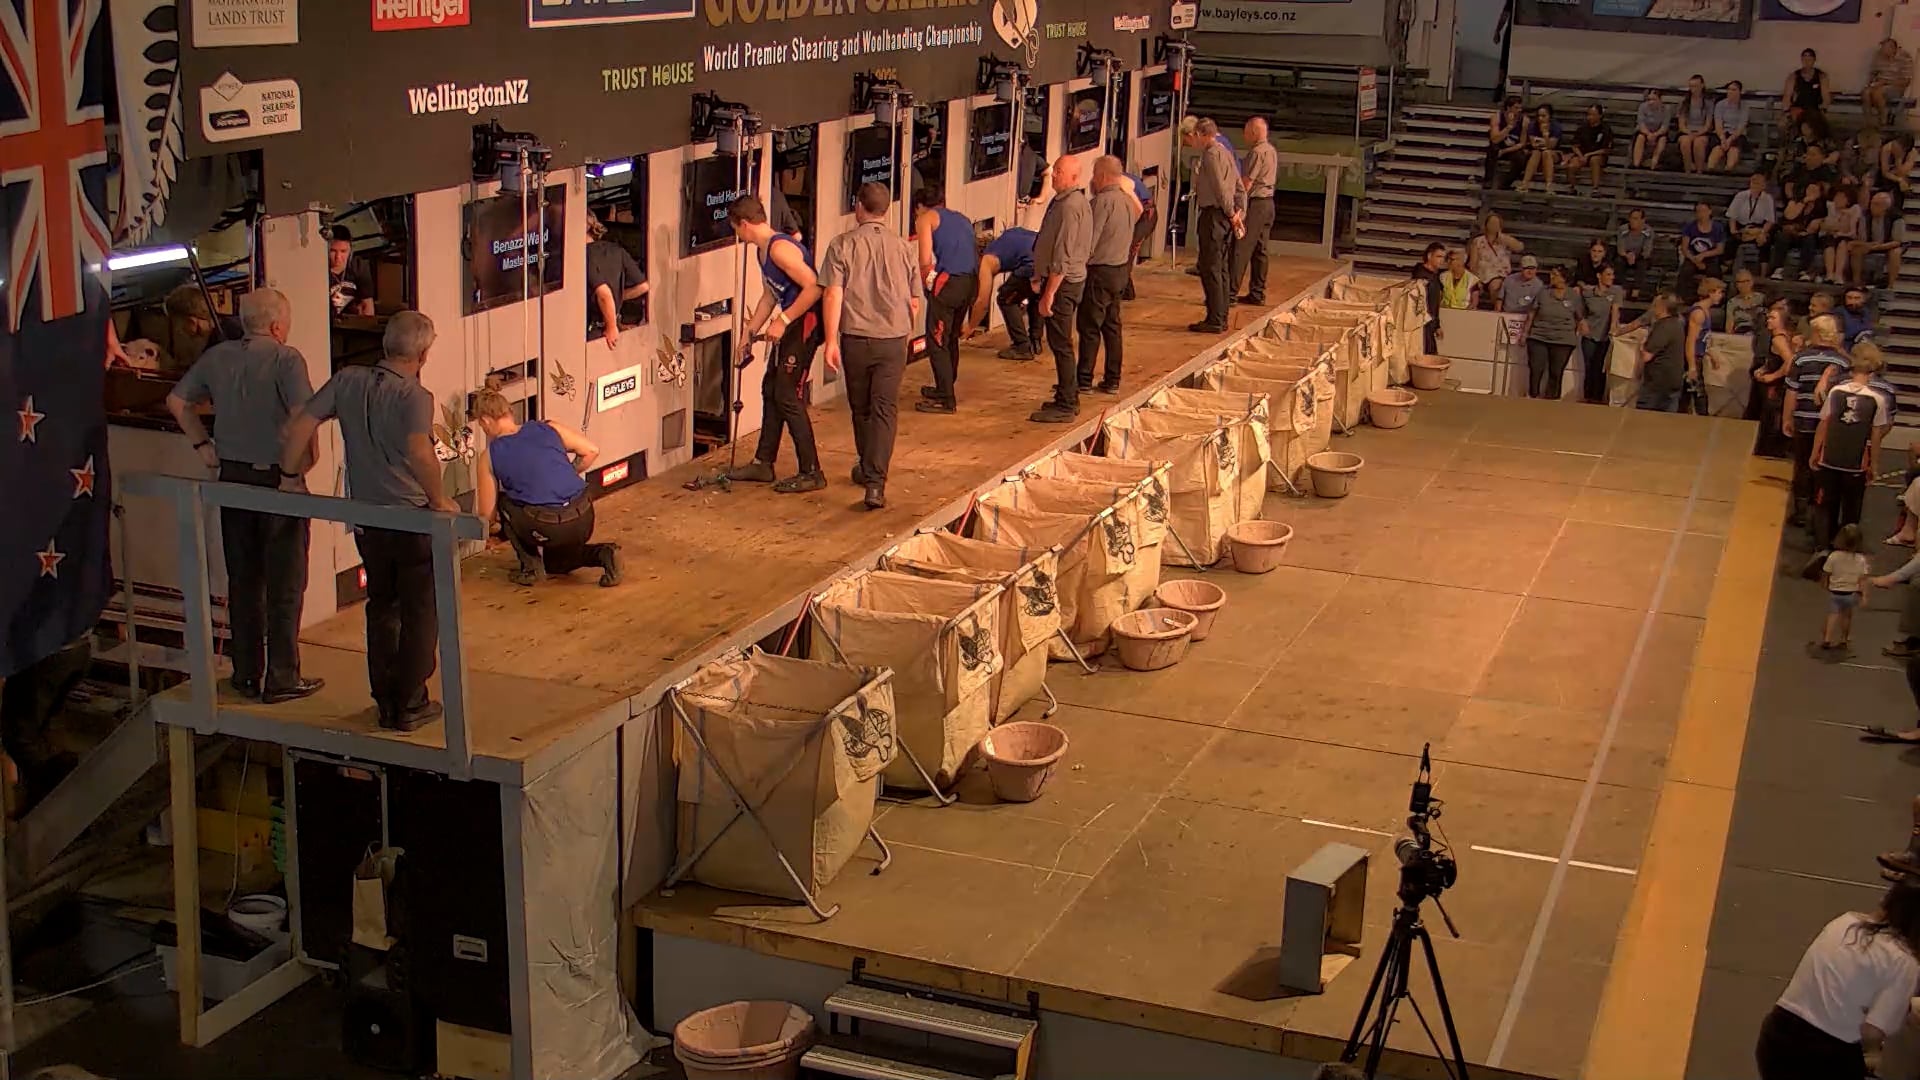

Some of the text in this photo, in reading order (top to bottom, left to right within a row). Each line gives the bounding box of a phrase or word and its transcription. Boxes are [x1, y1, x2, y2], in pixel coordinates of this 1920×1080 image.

[208, 10, 285, 25] LANDS TRUST
[703, 21, 982, 72] World Premier Shearing and Woolhandling Championship
[602, 62, 694, 91] TRUST HOUSE
[261, 89, 295, 101] NATIONAL
[408, 79, 529, 115] WellingtonNZ
[262, 100, 296, 113] SHEARING
[262, 113, 289, 125] CIRCUIT
[706, 191, 725, 206] David
[493, 228, 549, 255] Benazz Wad
[691, 235, 697, 247] 2
[502, 254, 538, 271] Masteton
[604, 378, 635, 398] BAYLEYS
